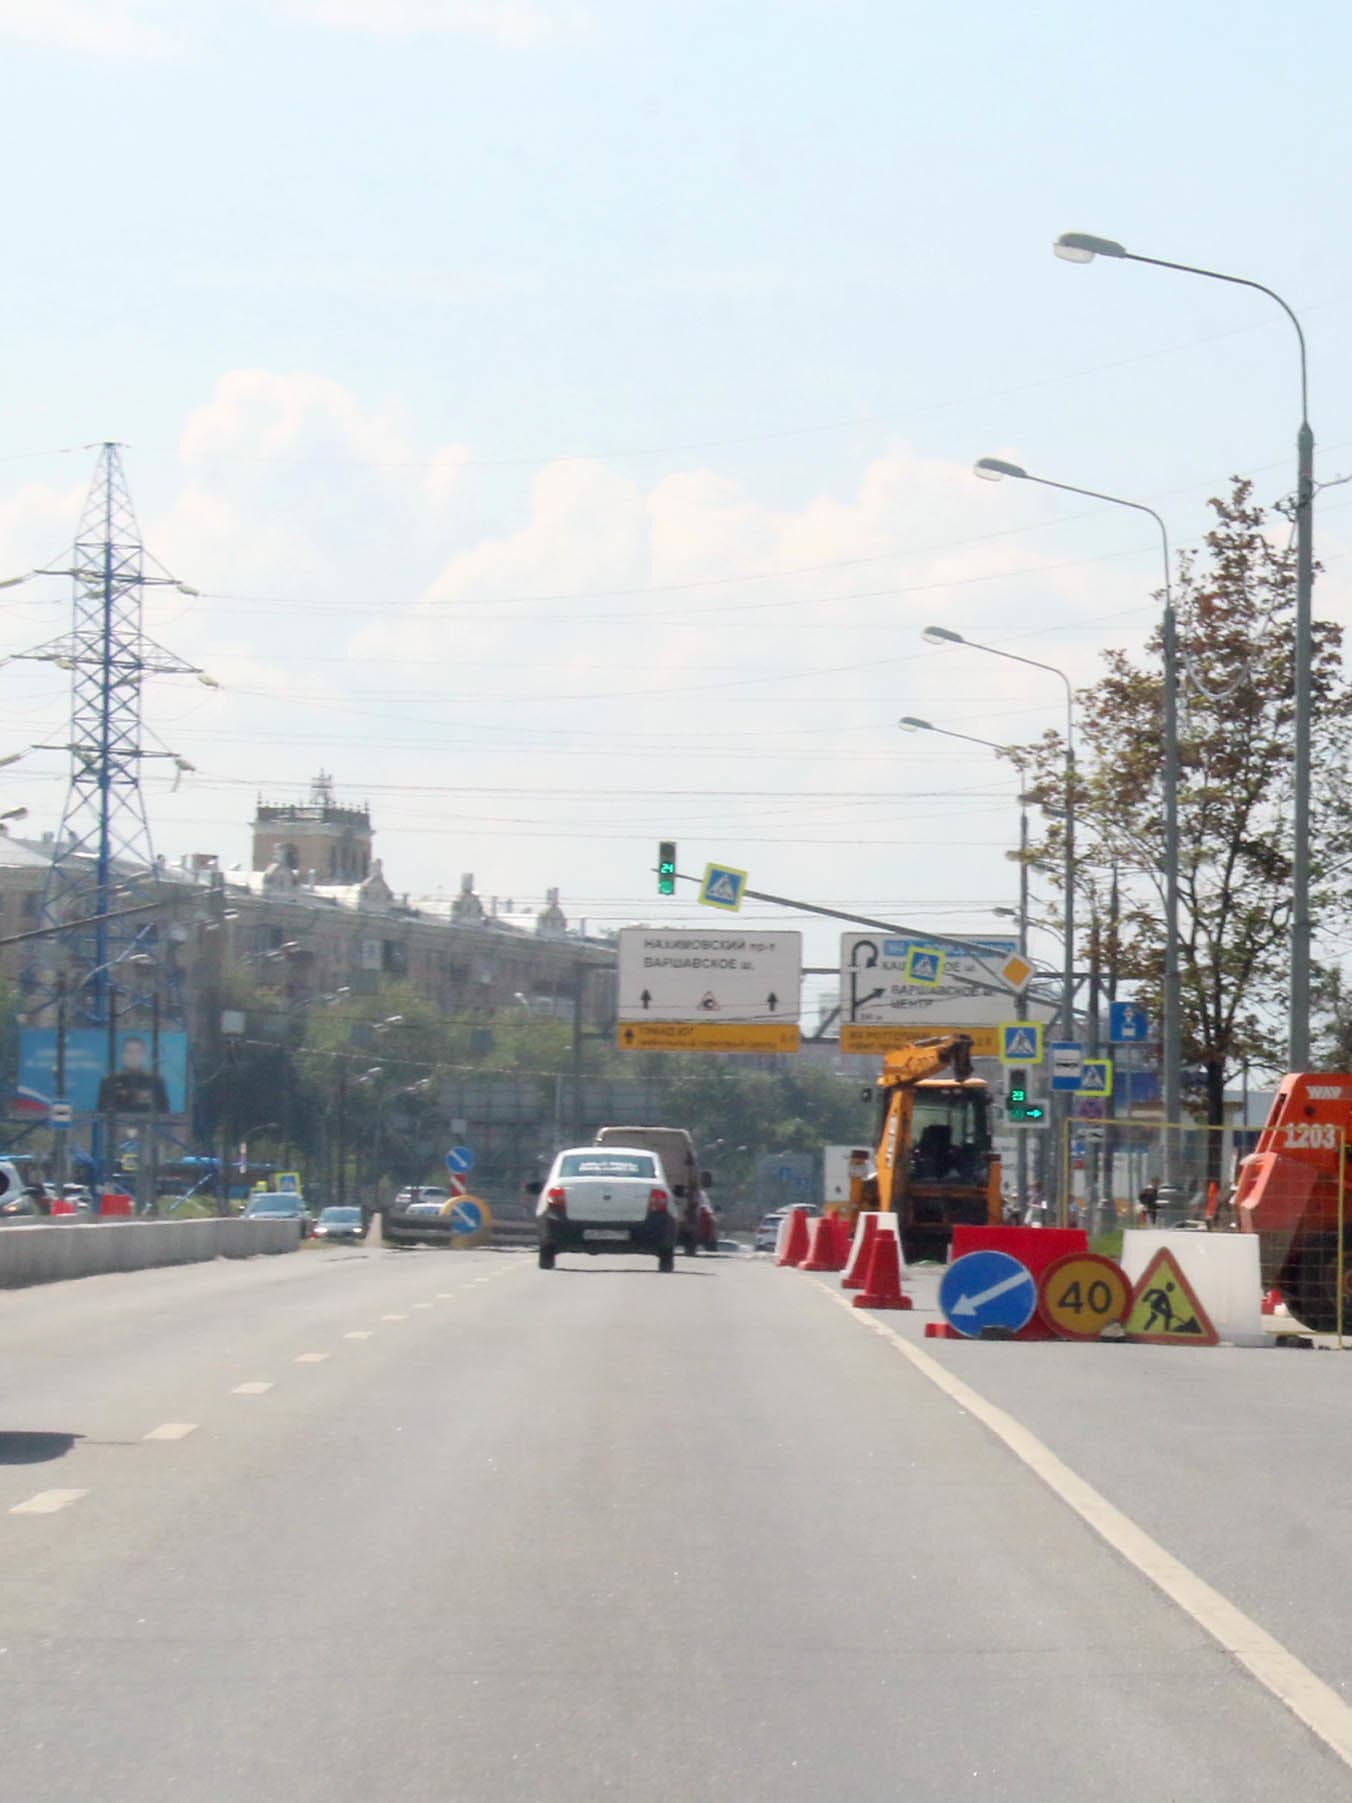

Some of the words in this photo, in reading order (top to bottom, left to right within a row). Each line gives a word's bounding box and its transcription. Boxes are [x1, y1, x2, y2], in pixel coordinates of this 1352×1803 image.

[643, 957, 737, 969] ВАРШАВСКОЕ
[1283, 1122, 1337, 1149] 1203
[1058, 1280, 1113, 1314] 40
